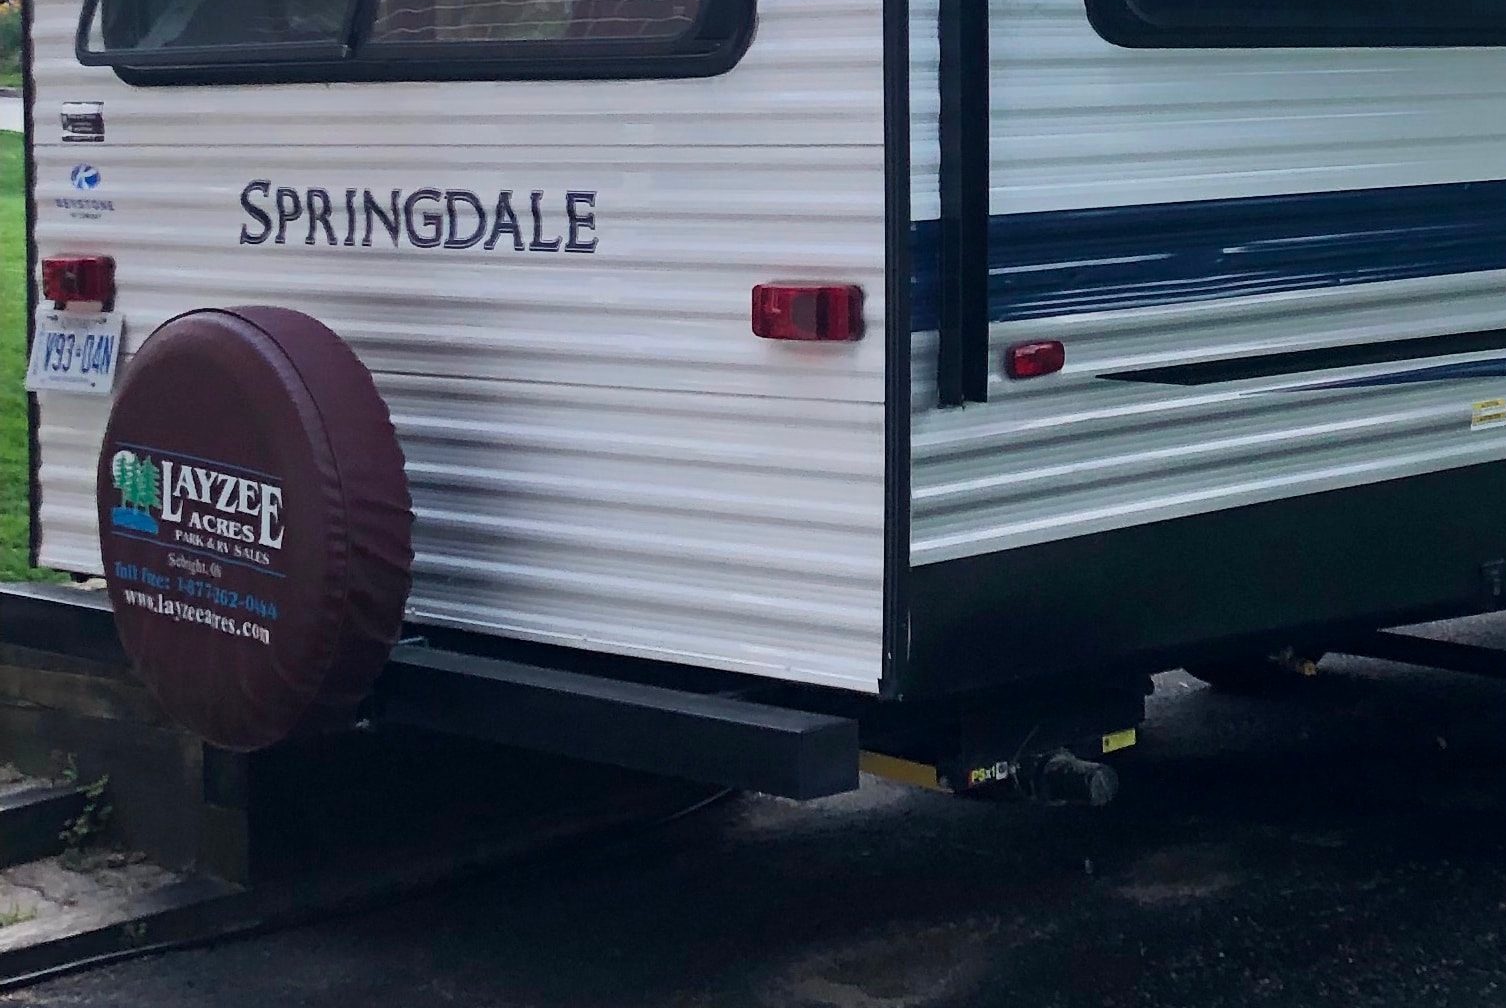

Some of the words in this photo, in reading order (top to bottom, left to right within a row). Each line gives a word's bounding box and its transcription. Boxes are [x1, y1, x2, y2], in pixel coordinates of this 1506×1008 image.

[239, 179, 600, 254] SPRINGDALE
[161, 460, 285, 550] LAYZEE
[189, 512, 255, 543] ACRES
[175, 529, 204, 547] PARK
[234, 545, 270, 565] SALES
